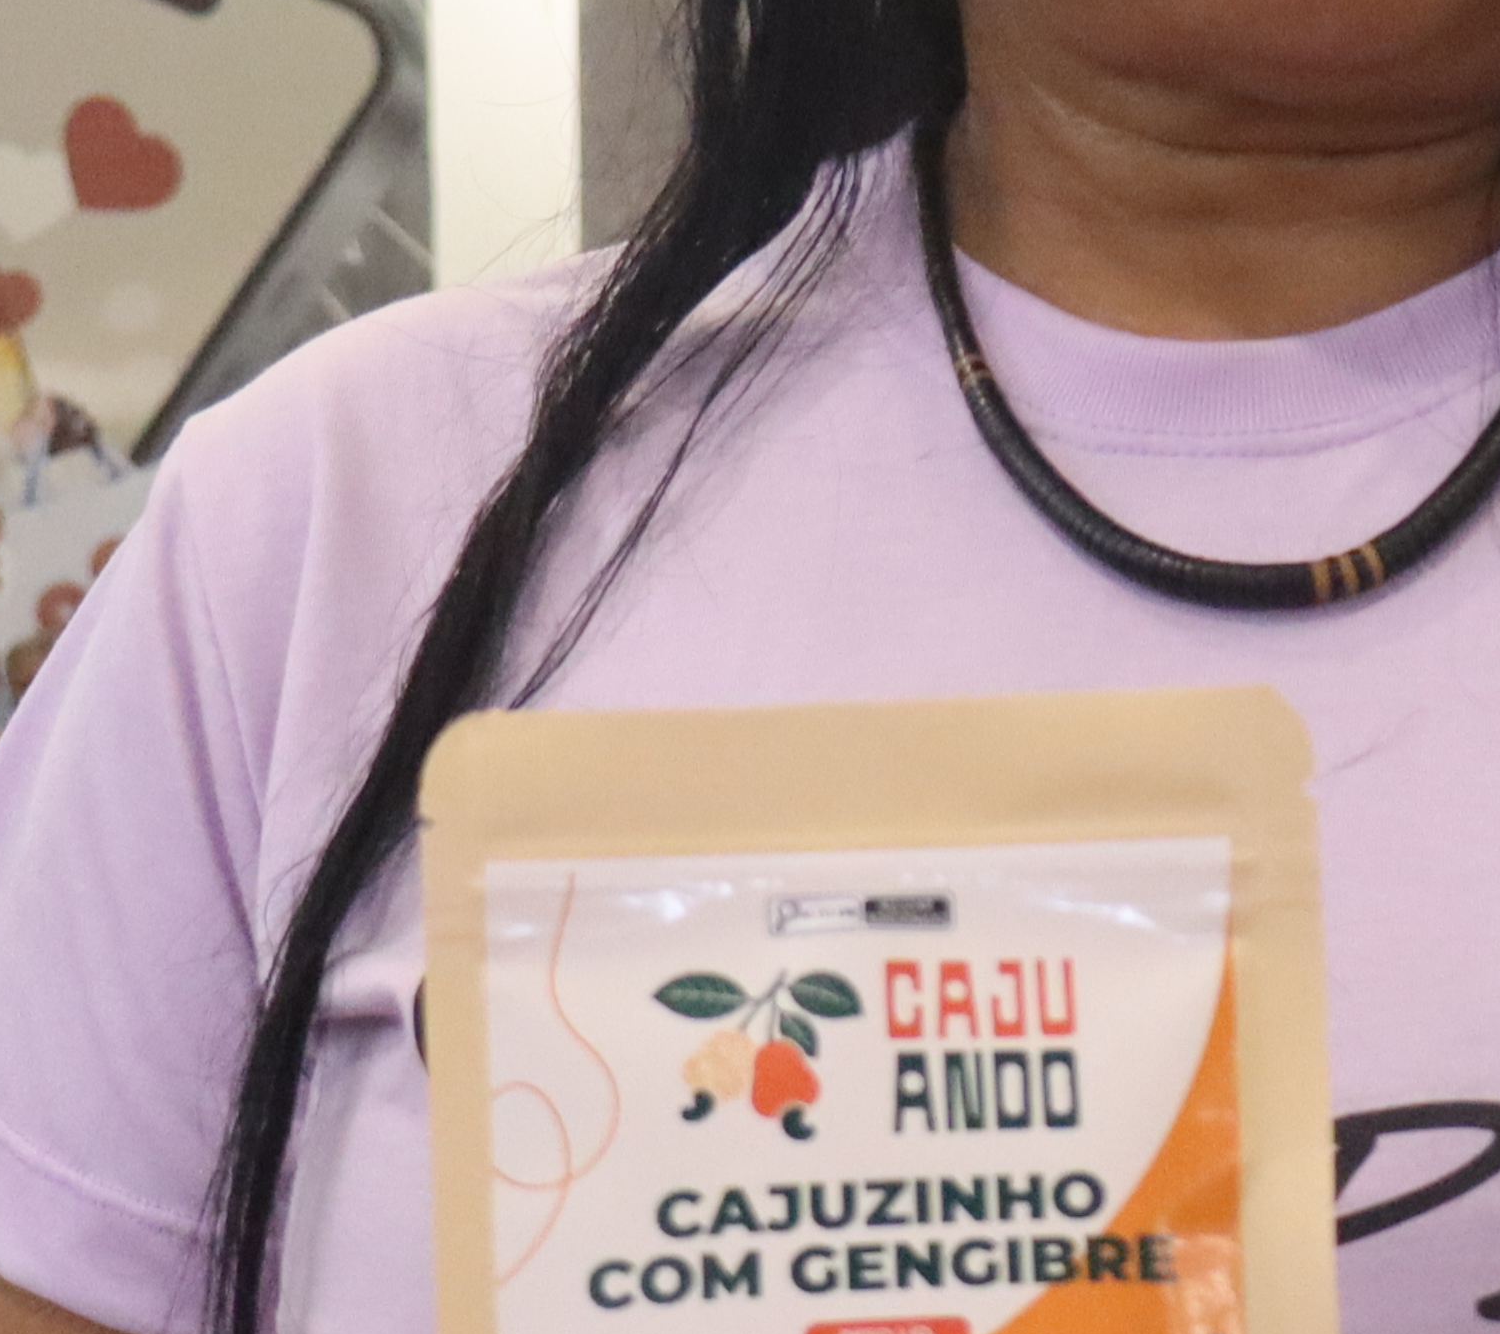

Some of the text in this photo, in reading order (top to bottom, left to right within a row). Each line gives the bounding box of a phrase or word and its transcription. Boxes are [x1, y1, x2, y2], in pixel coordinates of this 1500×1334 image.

[885, 958, 1075, 1038] CAJU
[894, 1049, 1080, 1133] ANDO
[656, 1169, 1105, 1239] CAJUZINHO
[587, 1234, 1178, 1311] COM GENGIBRE
